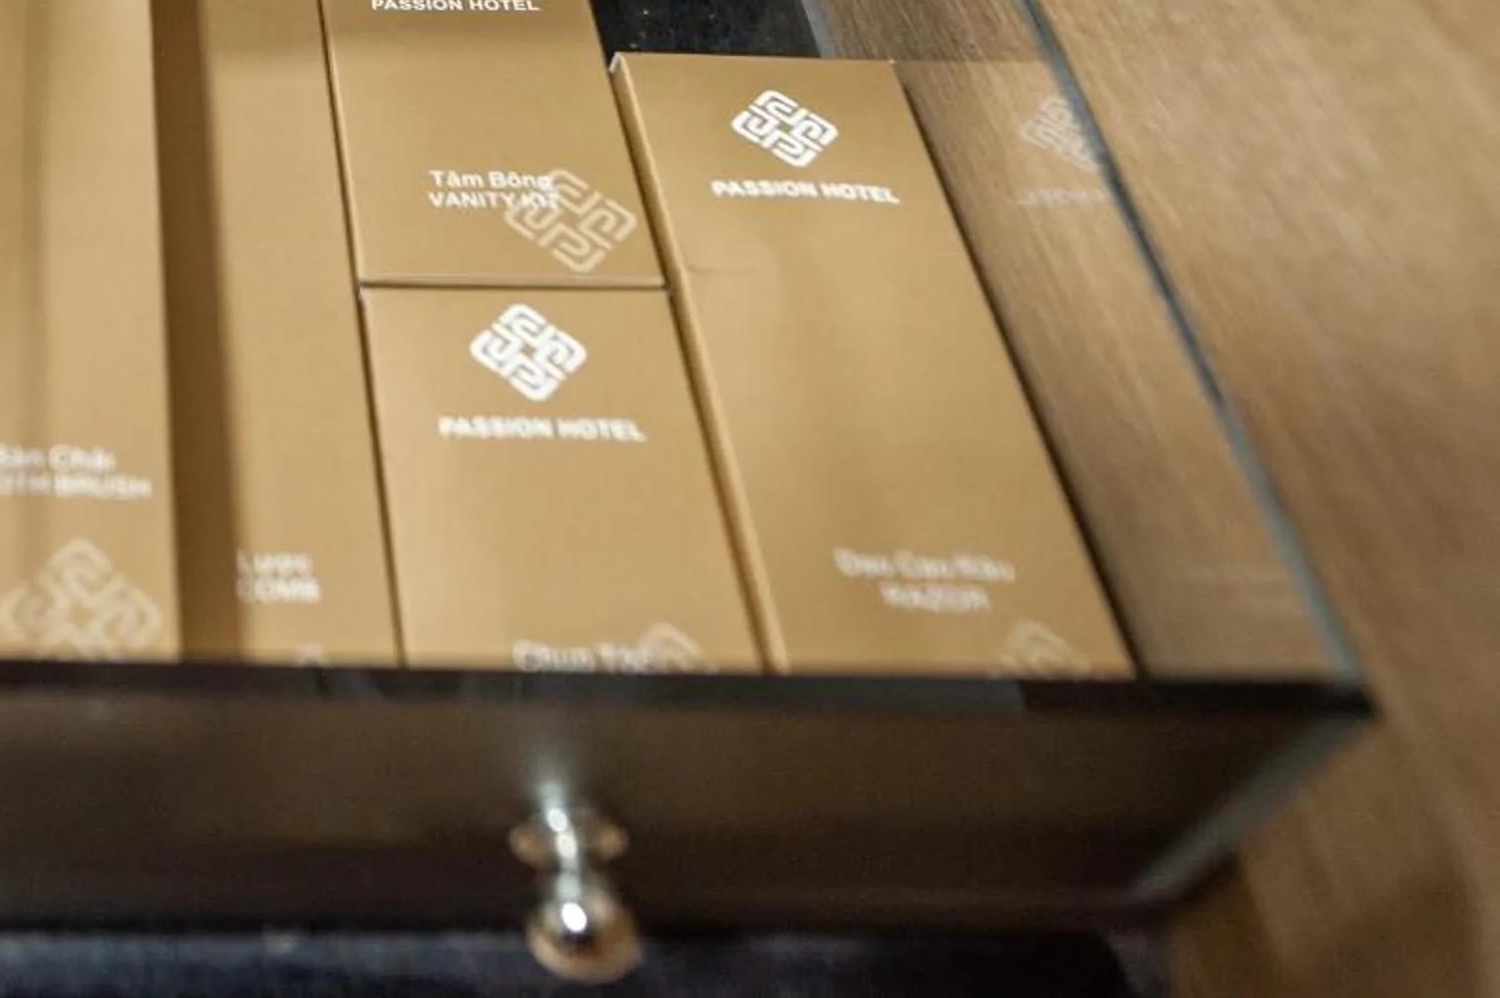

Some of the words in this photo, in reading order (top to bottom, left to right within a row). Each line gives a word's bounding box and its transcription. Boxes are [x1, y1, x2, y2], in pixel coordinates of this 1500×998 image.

[427, 191, 515, 209] VANITY
[710, 179, 818, 197] PASSION
[819, 181, 901, 205] HOTEL
[438, 415, 554, 440] PASSION
[555, 416, 647, 443] HOTEL
